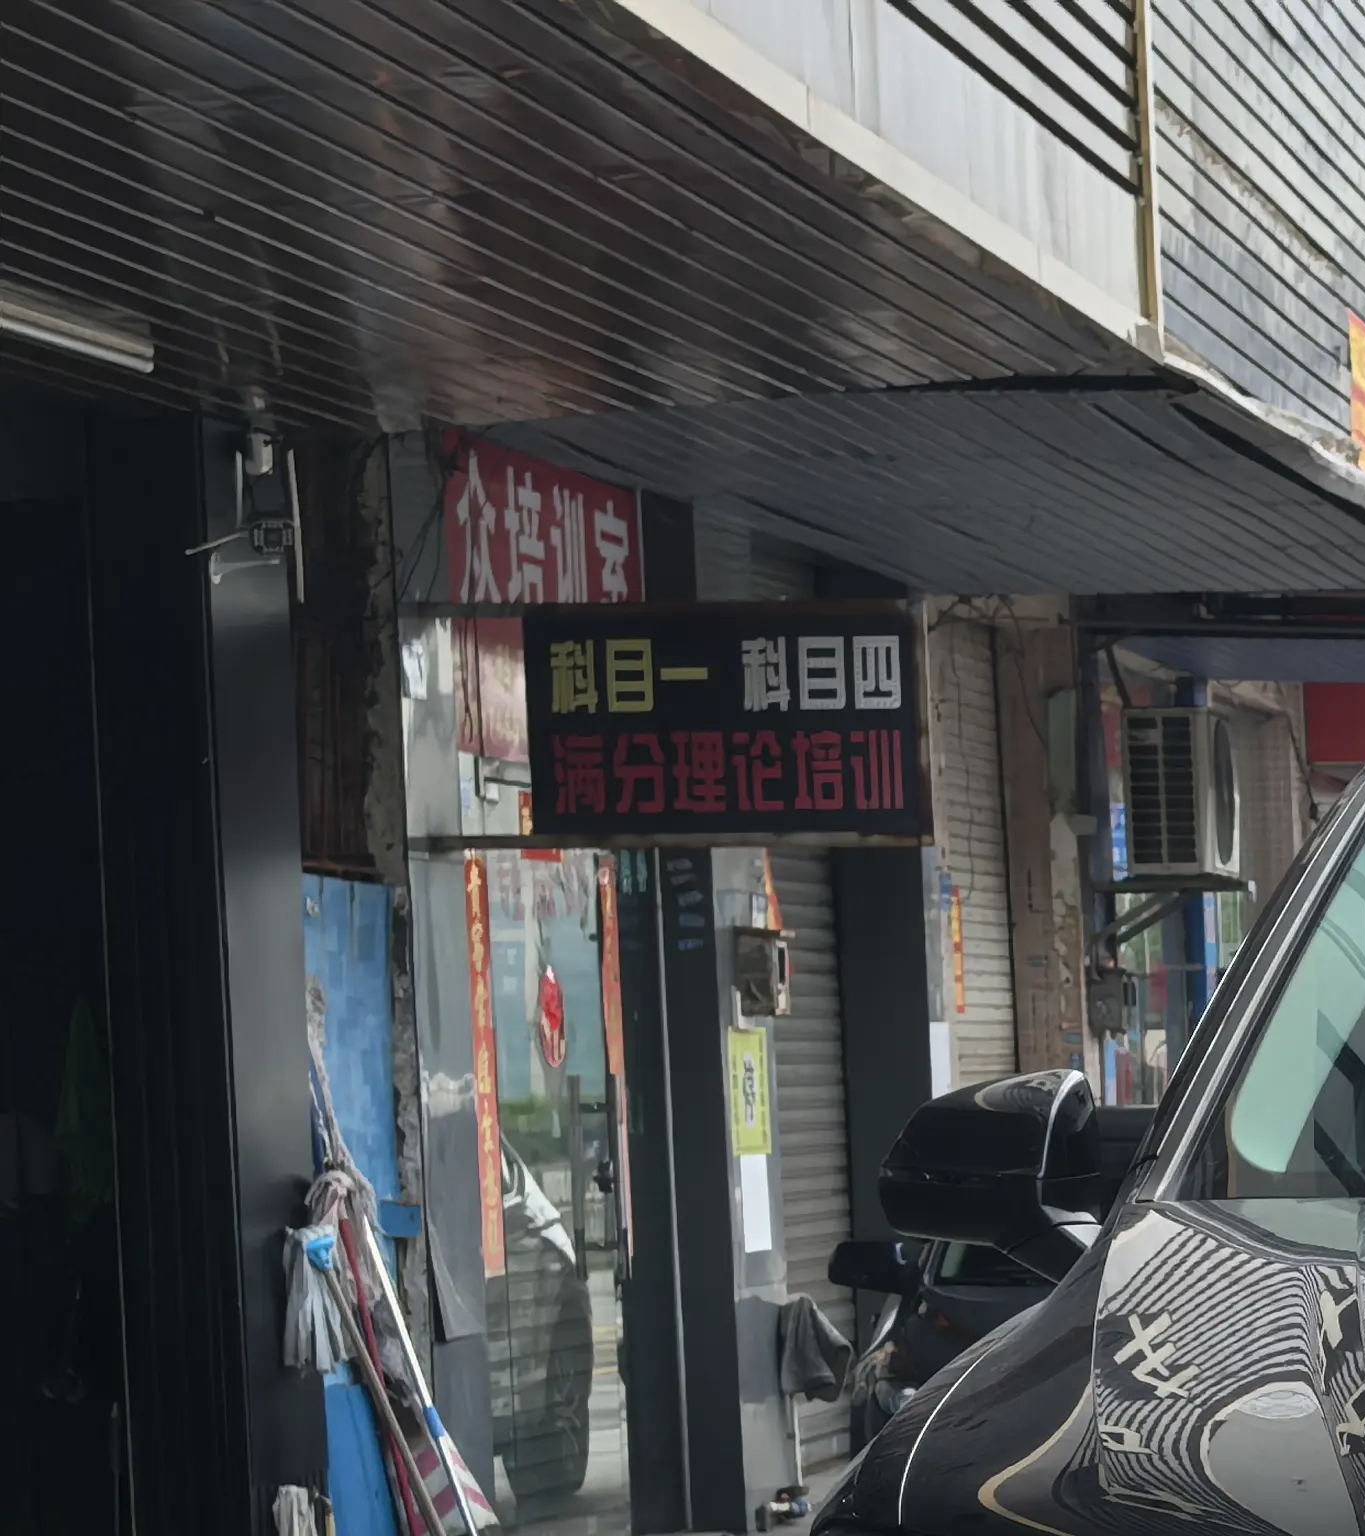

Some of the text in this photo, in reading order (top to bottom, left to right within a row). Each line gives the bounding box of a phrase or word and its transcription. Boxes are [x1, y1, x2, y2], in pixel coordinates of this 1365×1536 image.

[550, 638, 709, 714] 科目一
[741, 635, 902, 711] 科目四
[553, 729, 904, 814] 满分理论培训
